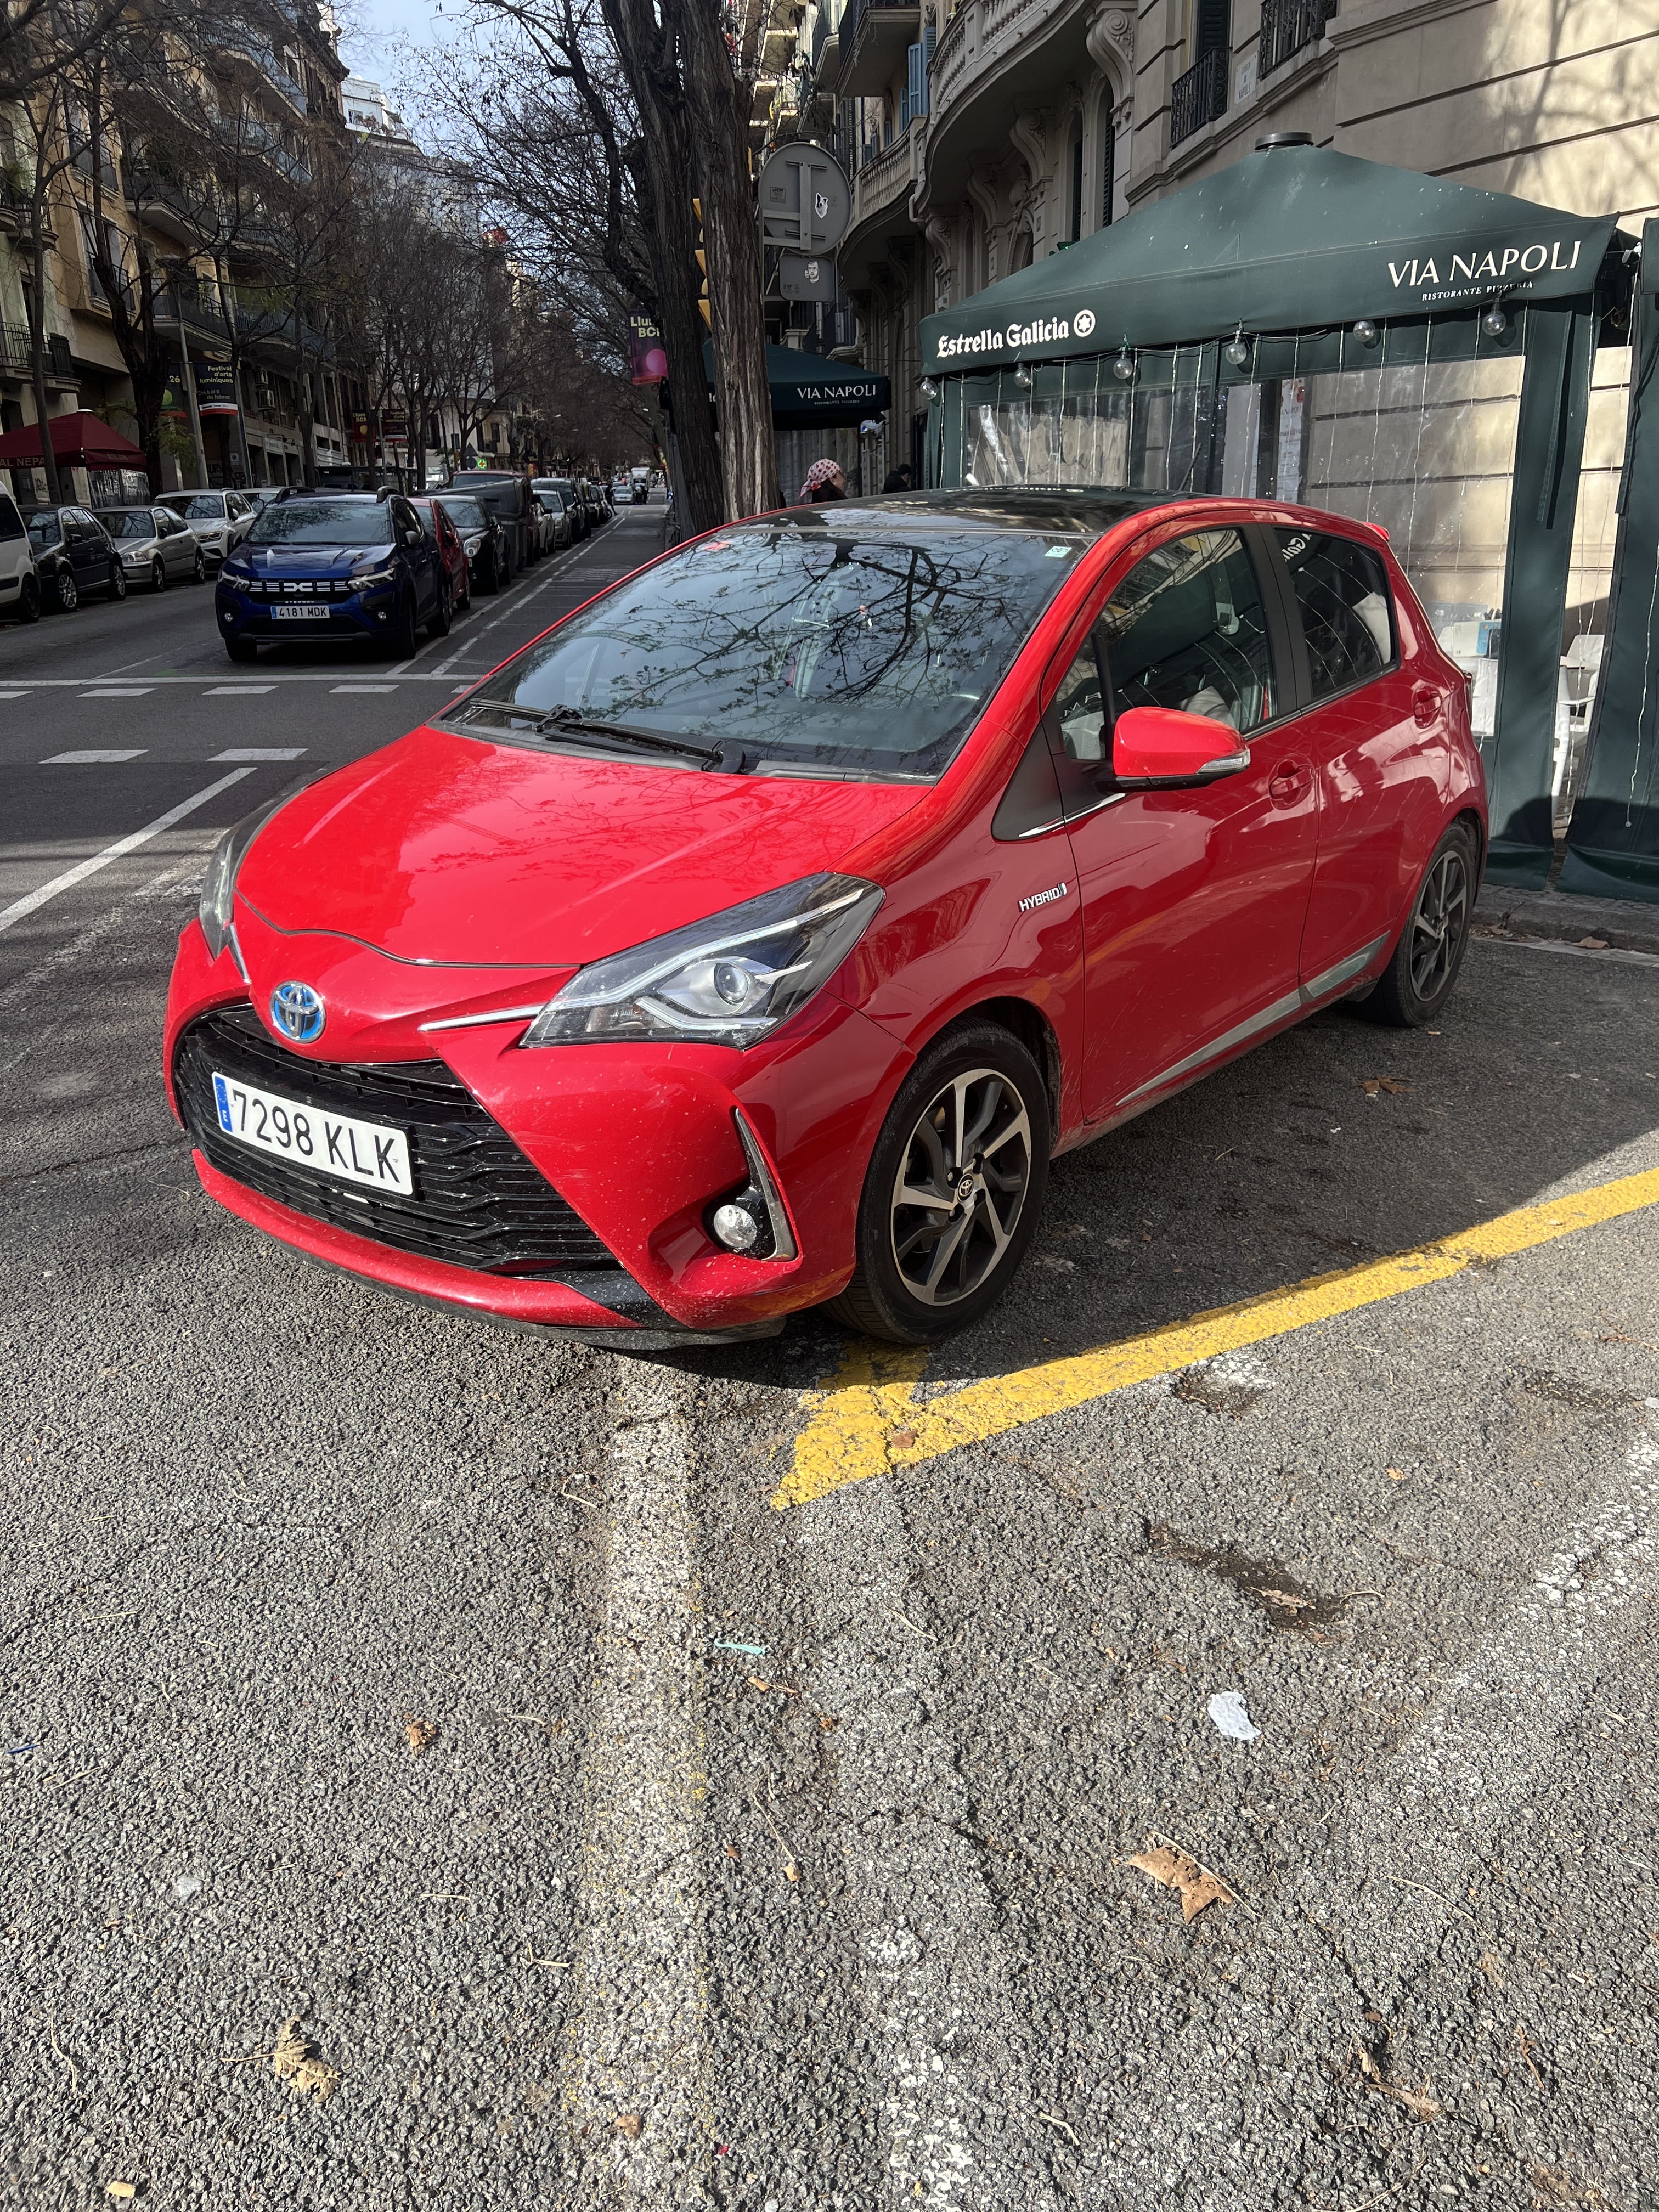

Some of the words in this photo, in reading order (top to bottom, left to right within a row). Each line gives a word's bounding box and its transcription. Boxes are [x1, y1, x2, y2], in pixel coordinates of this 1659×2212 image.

[1388, 257, 1440, 288] VIA
[1449, 240, 1581, 281] NAPOLI
[1422, 286, 1481, 301] RISTORANTE
[630, 316, 652, 327] Llu
[936, 329, 1003, 358] Estrella
[1006, 317, 1069, 347] Galicia
[797, 386, 821, 399] VIA
[823, 384, 877, 398] NAPOLI
[17, 457, 44, 466] NEPA
[279, 607, 303, 617] 4181
[308, 607, 327, 617] MDK
[1019, 887, 1061, 912] HYBRID
[222, 1109, 228, 1122] E
[232, 1089, 313, 1155] 7298
[325, 1121, 400, 1183] KLK
